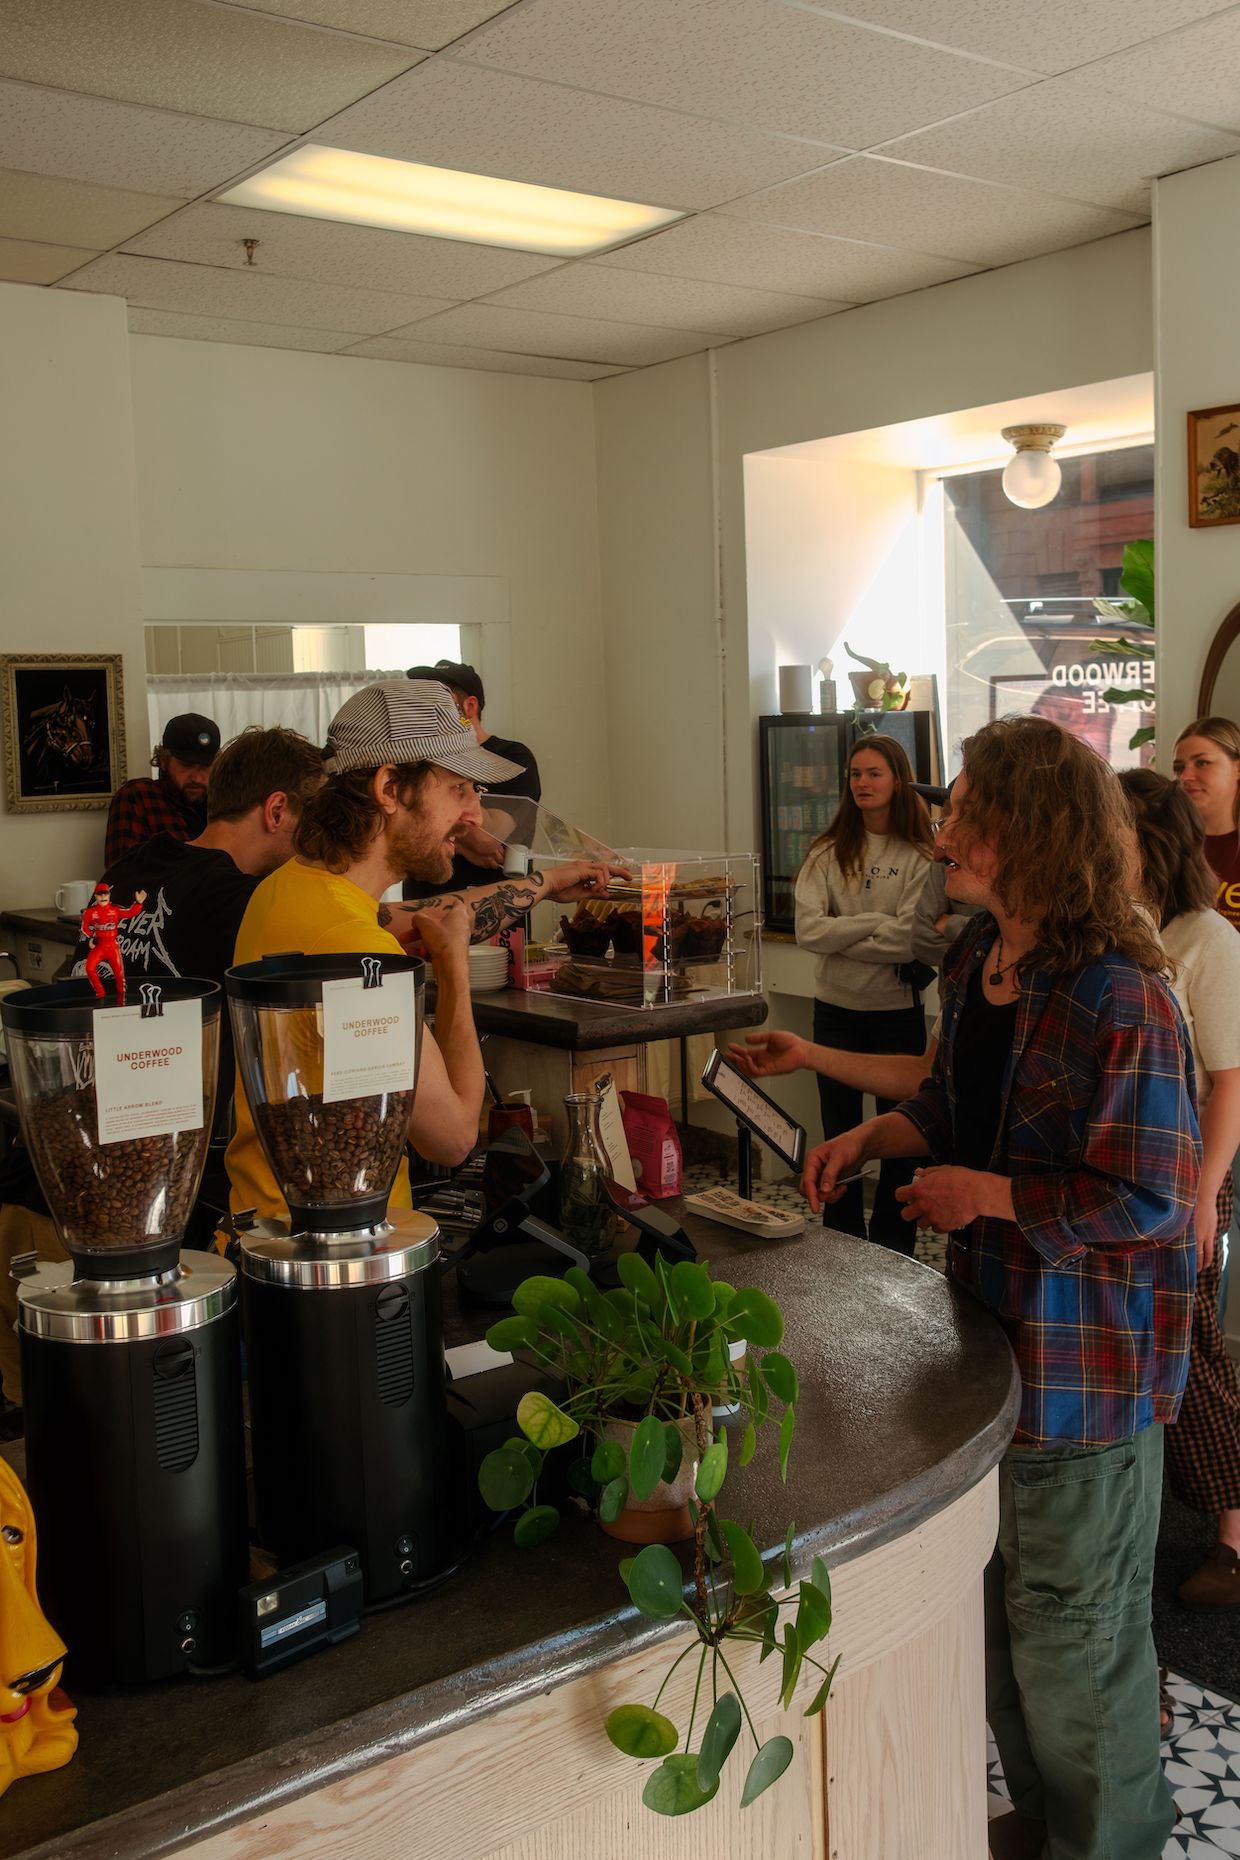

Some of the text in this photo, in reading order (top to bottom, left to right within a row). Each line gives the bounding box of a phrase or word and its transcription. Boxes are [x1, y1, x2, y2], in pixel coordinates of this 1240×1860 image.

[342, 1015, 400, 1030] UNDERWOOD
[354, 1026, 388, 1038] COFFEE
[116, 1046, 183, 1062] UNDERWOOD
[130, 1057, 170, 1070] COFFEE
[105, 1105, 122, 1113] LITTLE
